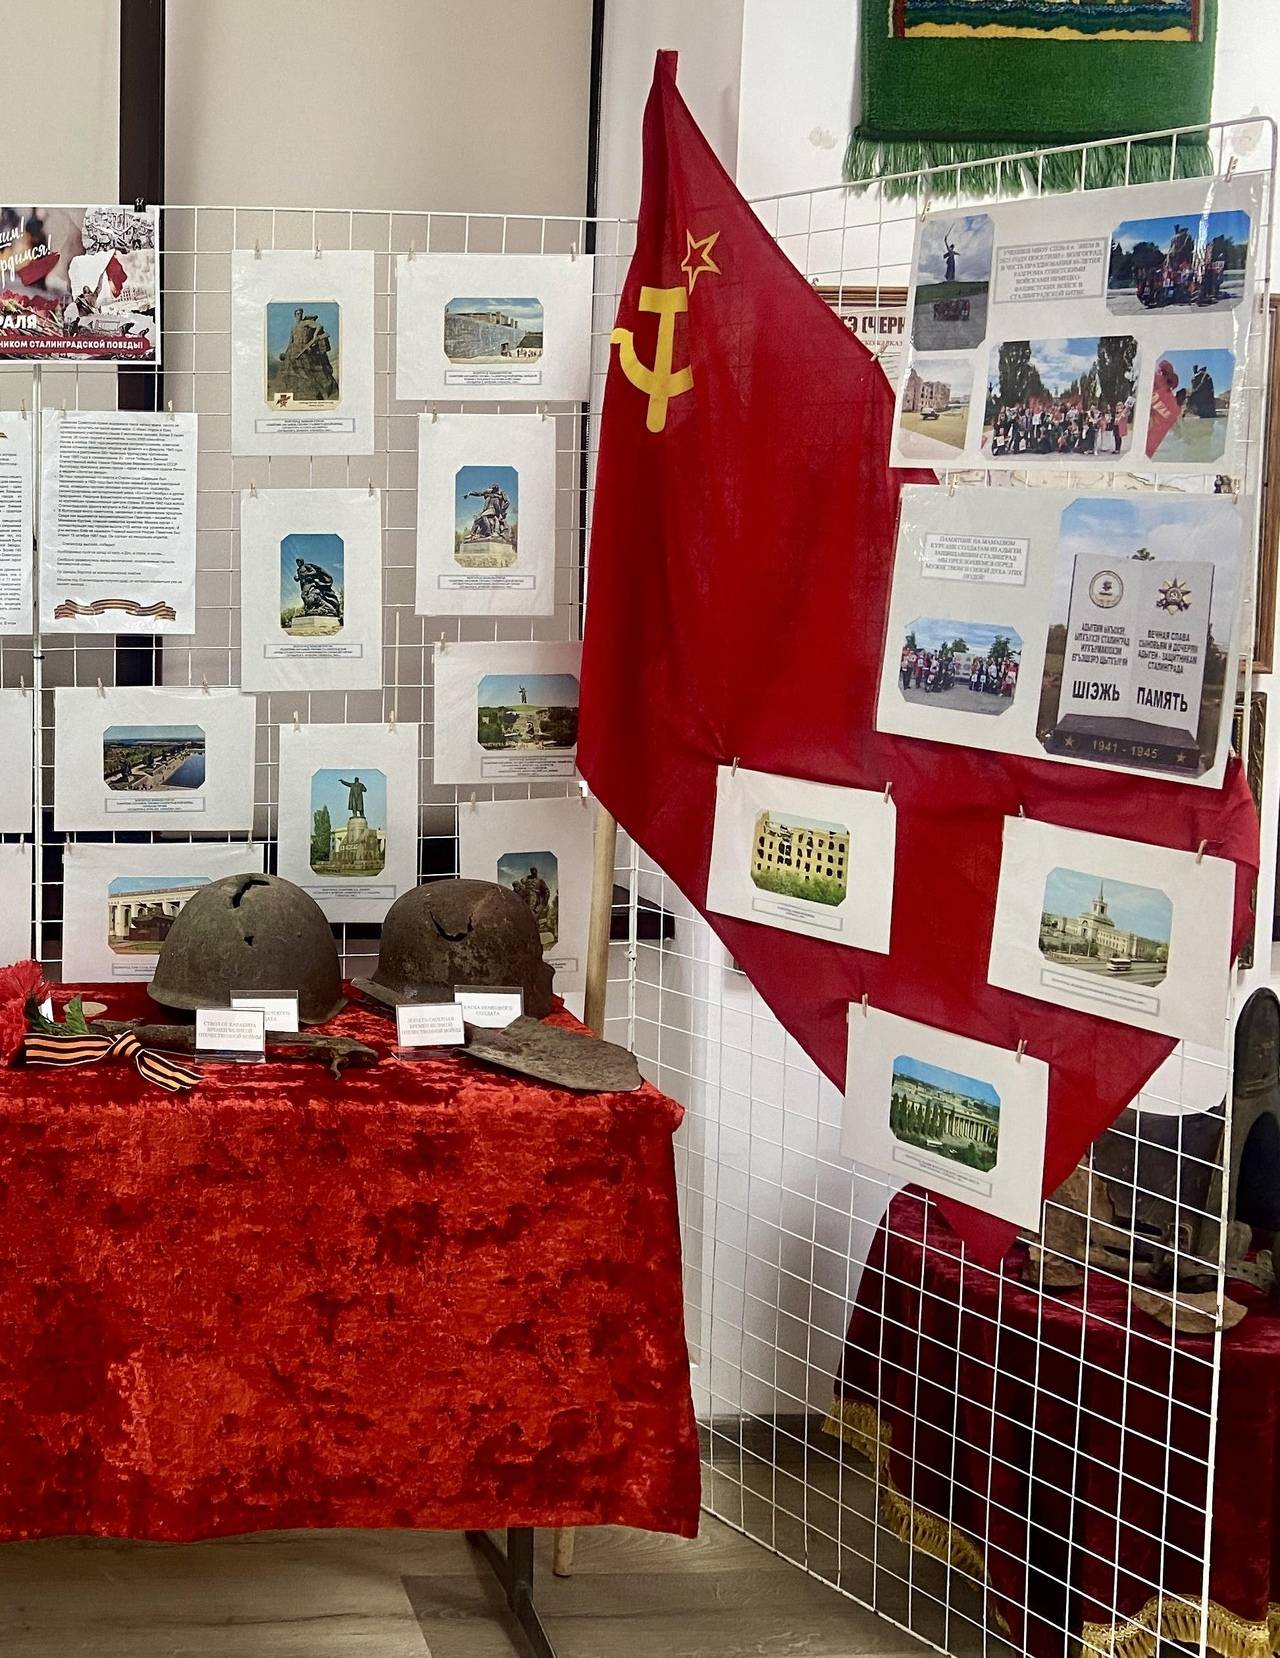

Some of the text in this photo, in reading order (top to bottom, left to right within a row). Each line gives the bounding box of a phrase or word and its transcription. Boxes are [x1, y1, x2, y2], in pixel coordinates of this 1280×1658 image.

[30, 340, 105, 350] СТАЛИНГРАДСКОЙ
[107, 341, 143, 349] ПОБЕДЫ!
[1148, 630, 1190, 642] ВЕЧНАЯ СЛАВА
[1139, 639, 1167, 650] СЫНОВЬЯМ
[1173, 643, 1198, 654] ДОЧЕРЯМ
[1162, 652, 1198, 664] ЗАЩИТНИКАМ
[1148, 661, 1183, 674] СТАЛИНГРАДА
[1137, 687, 1188, 712] ПАМЯТЬ
[1092, 740, 1118, 753] 1941
[1131, 746, 1158, 759] 1945
